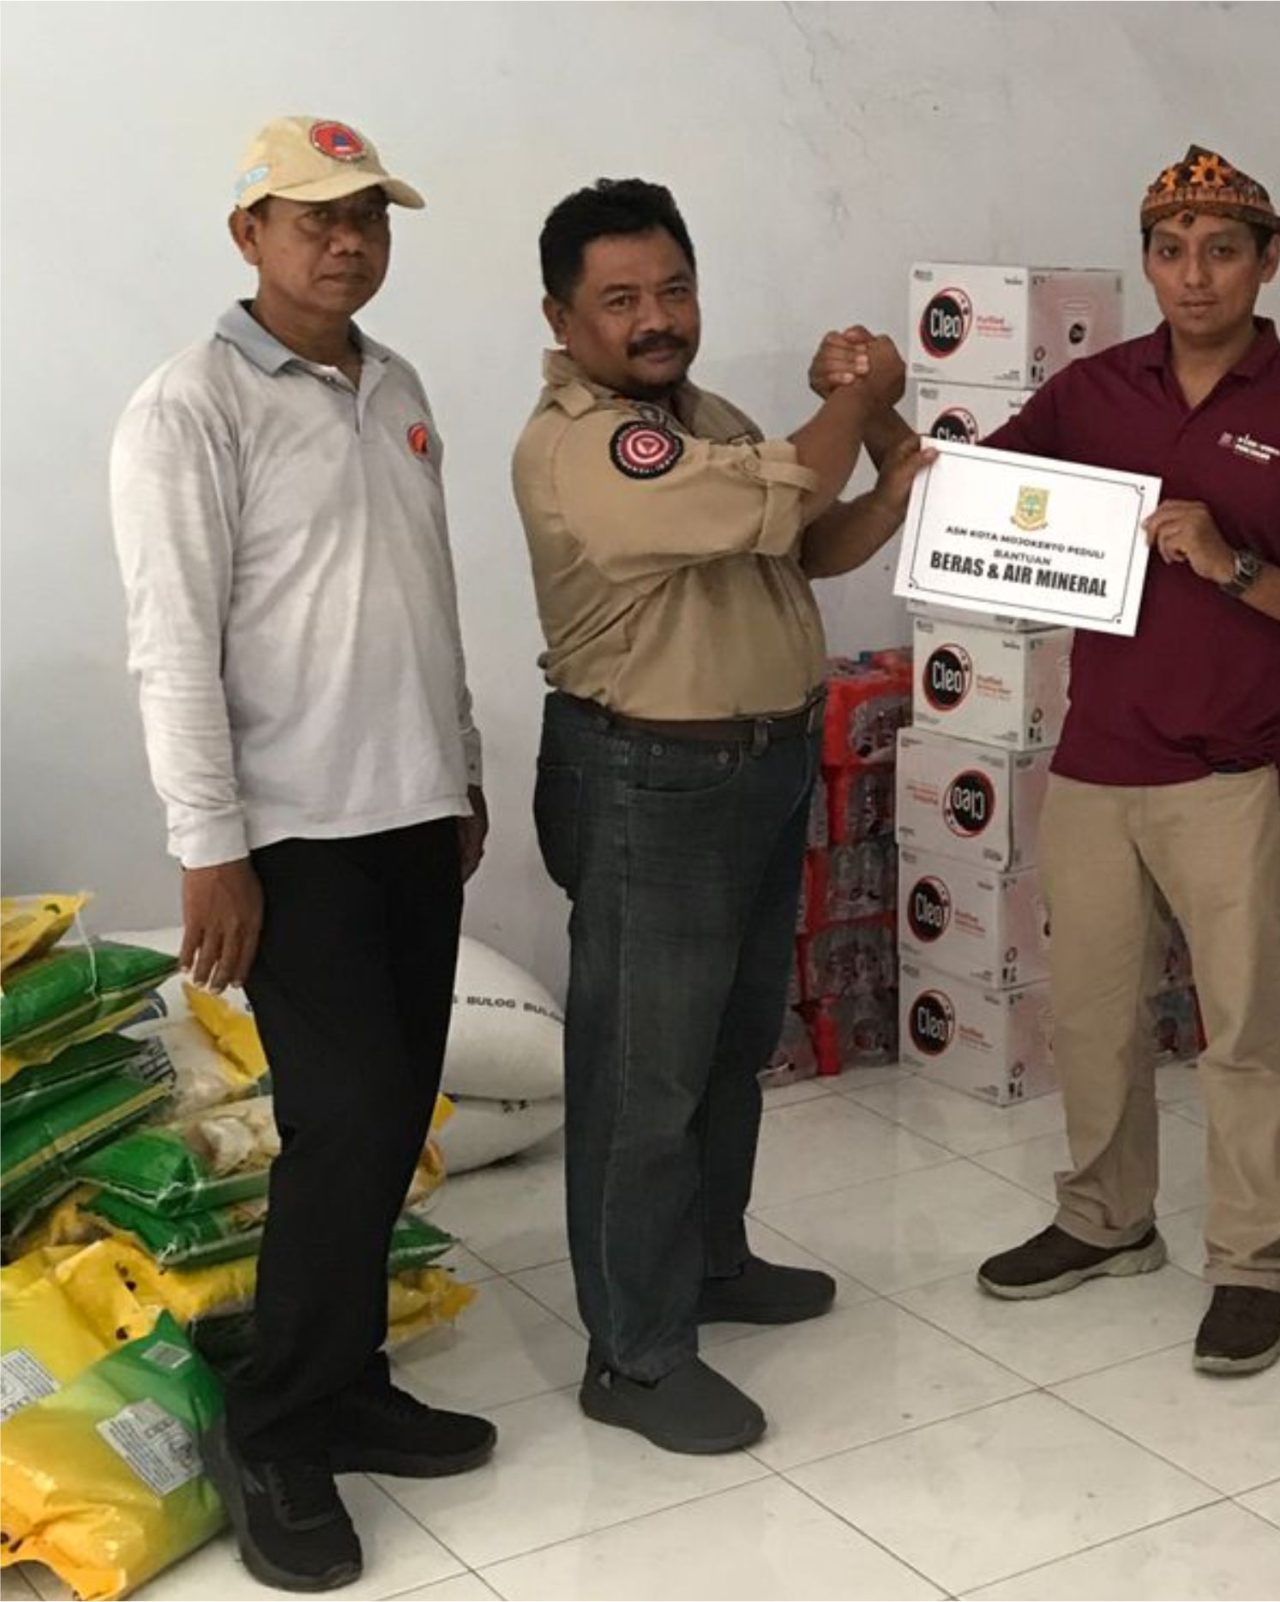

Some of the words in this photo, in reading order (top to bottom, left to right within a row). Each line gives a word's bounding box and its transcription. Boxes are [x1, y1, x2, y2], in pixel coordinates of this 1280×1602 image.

[930, 308, 963, 338] Cleo
[945, 525, 967, 537] ASN
[969, 530, 998, 541] KOTA
[1000, 534, 1065, 553] MOJOKERTO
[1067, 545, 1105, 559] PEDULI
[993, 548, 1050, 566] BANTUAN
[930, 550, 985, 577] BERAS
[987, 562, 999, 579] &
[1002, 563, 1033, 585] AIR
[1035, 568, 1107, 597] MINERAL
[932, 660, 963, 693] Cleo
[952, 786, 985, 820] Cleo
[915, 892, 943, 928] Cleo
[467, 995, 516, 1009] BULOG
[917, 1007, 946, 1041] Cleo
